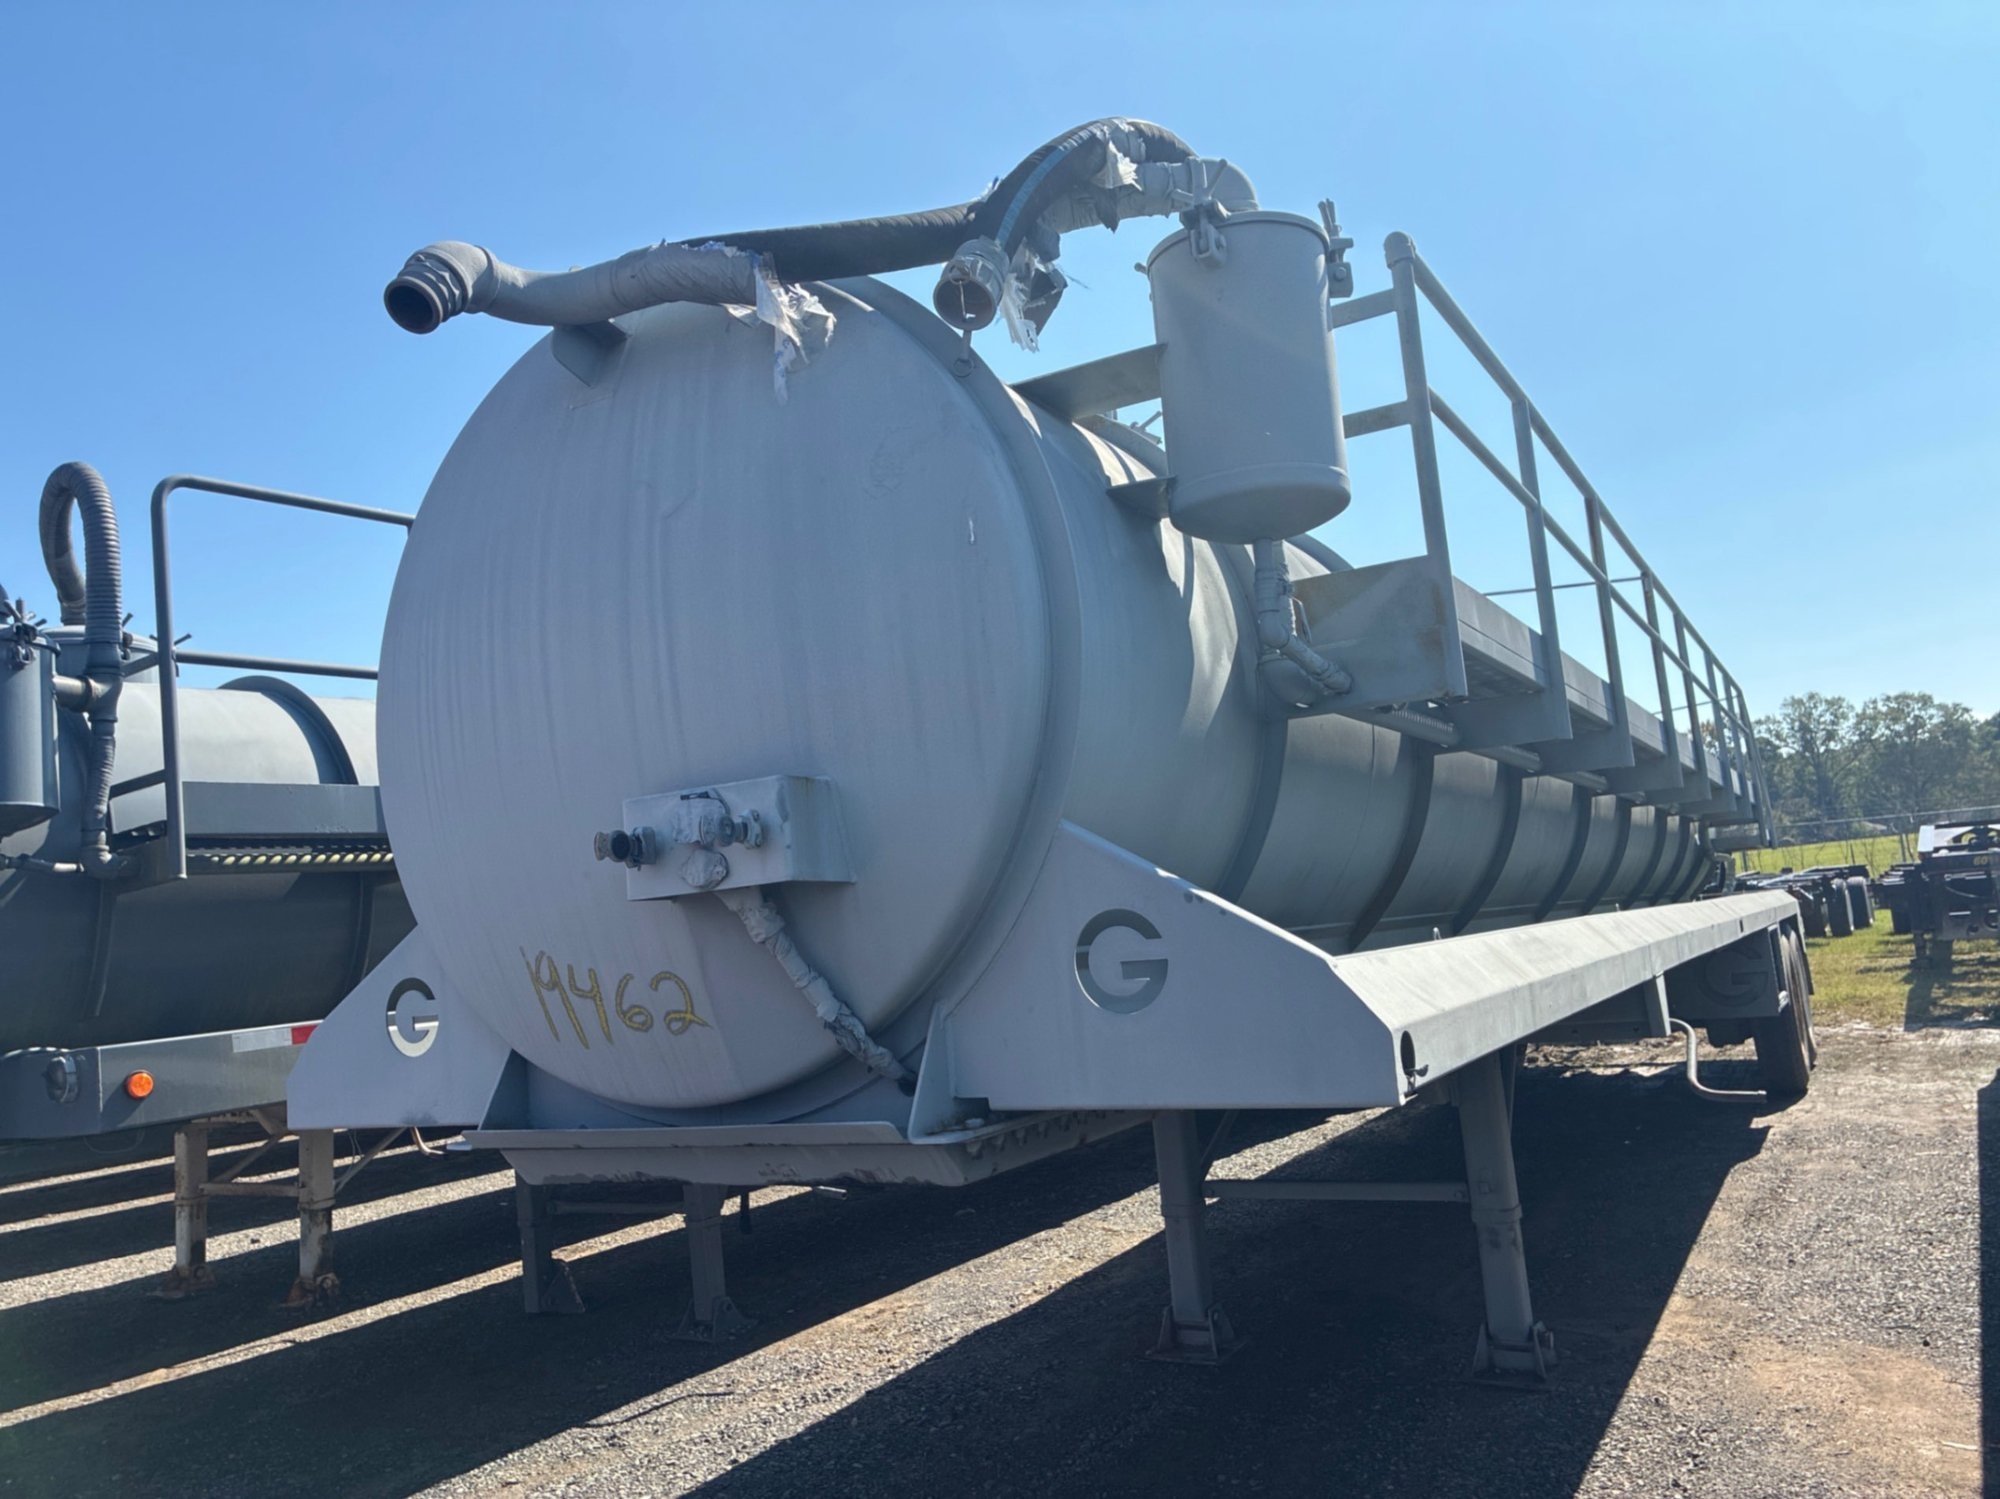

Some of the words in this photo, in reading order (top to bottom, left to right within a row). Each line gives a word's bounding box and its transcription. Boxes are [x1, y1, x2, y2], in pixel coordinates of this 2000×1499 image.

[1074, 908, 1169, 1015] G
[1698, 947, 1769, 1008] G
[386, 977, 440, 1058] G
